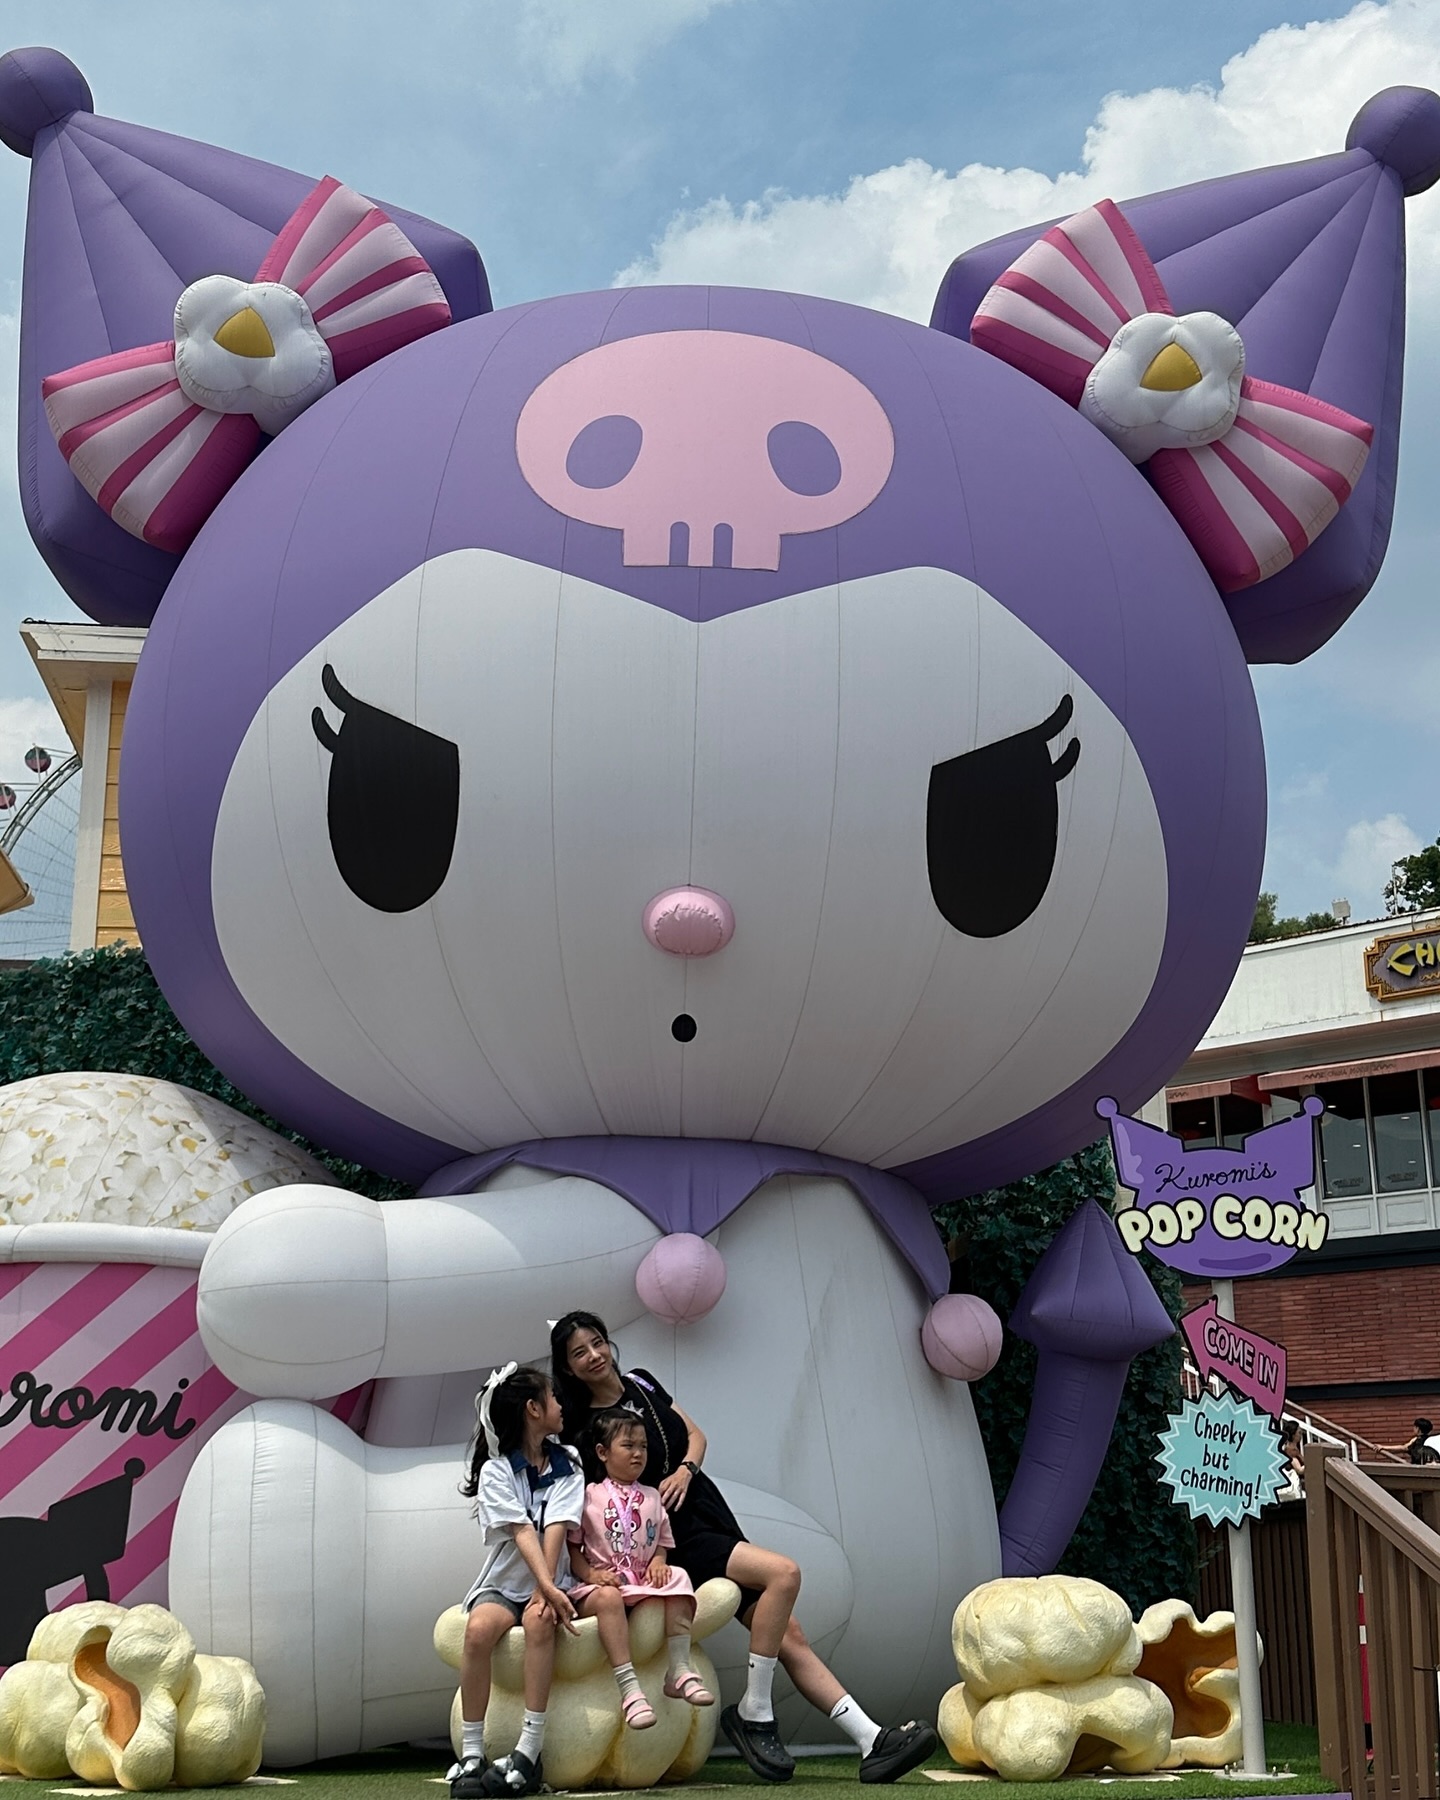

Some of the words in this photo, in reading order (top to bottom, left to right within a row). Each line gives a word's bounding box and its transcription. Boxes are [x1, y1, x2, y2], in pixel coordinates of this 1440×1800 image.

[1154, 1161, 1277, 1193] Kuromi's
[1116, 1198, 1206, 1254] POP
[1212, 1194, 1328, 1252] CORN
[1203, 1318, 1255, 1378] COME
[1258, 1352, 1279, 1394] IN
[1194, 1411, 1247, 1453] Cheeky
[1202, 1443, 1230, 1471] but
[1180, 1466, 1262, 1509] charming!
